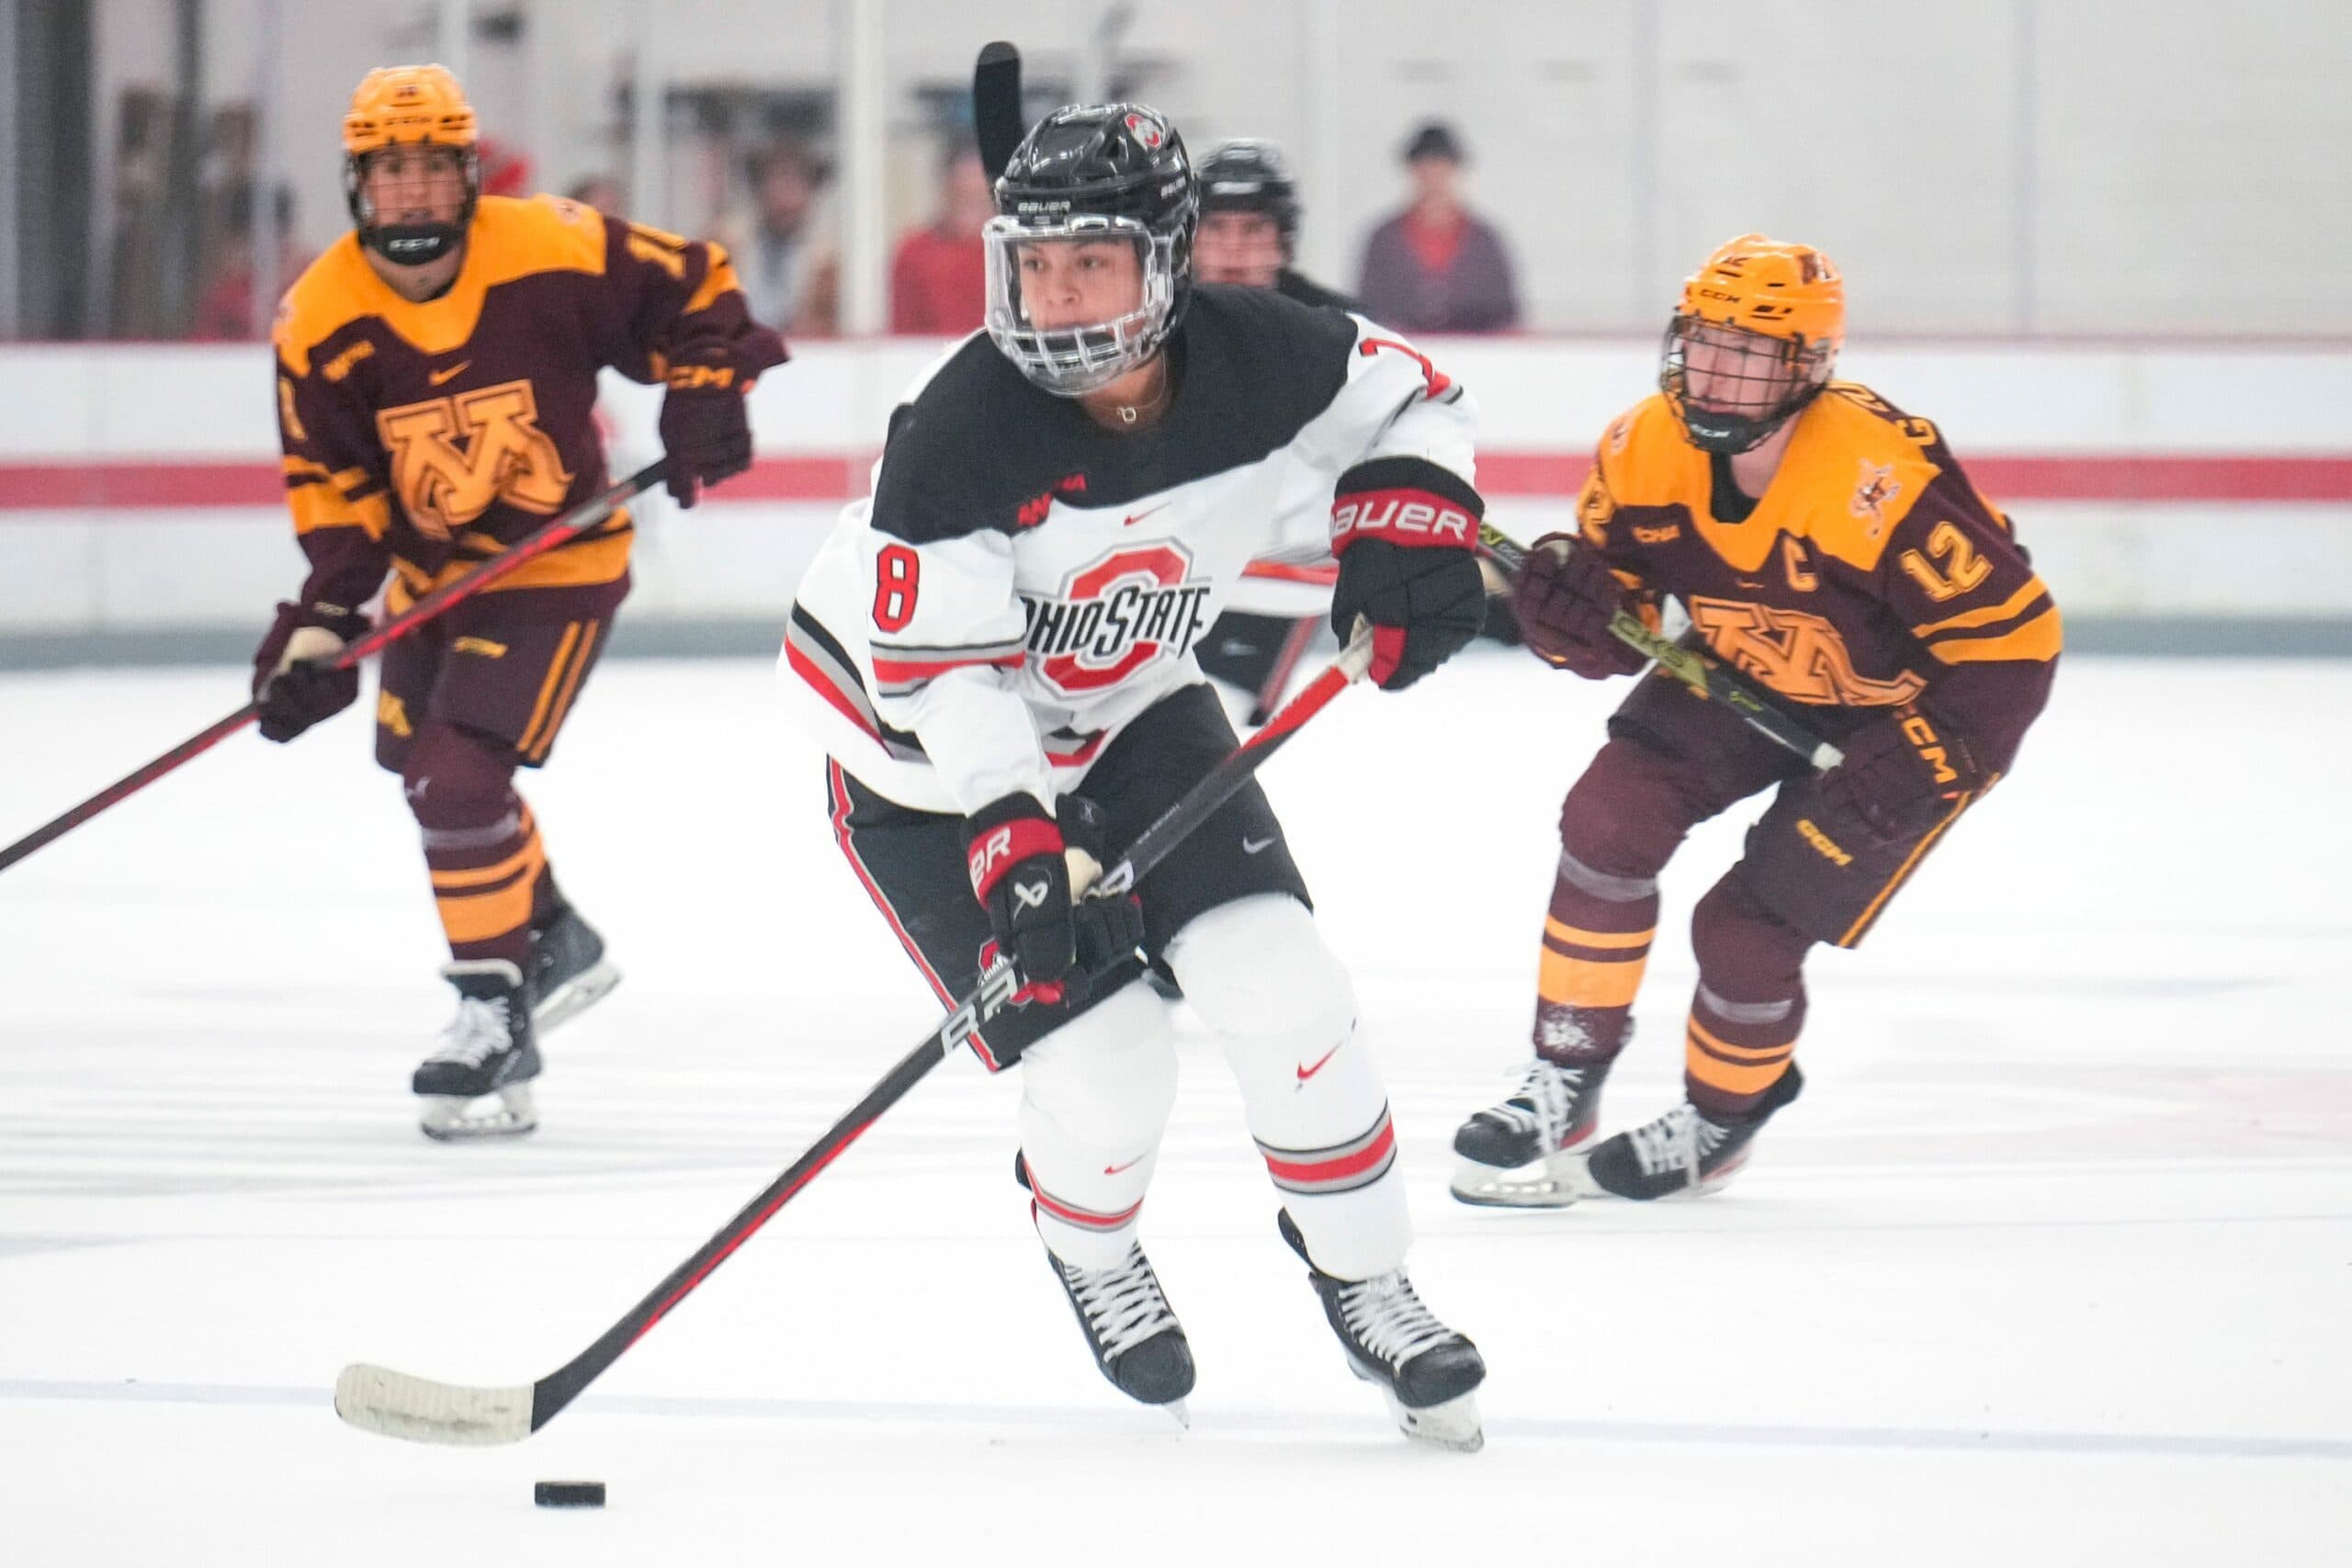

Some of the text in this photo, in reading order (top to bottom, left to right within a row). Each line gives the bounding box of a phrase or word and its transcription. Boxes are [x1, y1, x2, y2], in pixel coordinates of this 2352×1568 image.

[1329, 501, 1469, 542] AUER
[873, 542, 921, 635] 8
[1781, 535, 1818, 592] C
[1900, 521, 1994, 603] 12
[1898, 708, 1959, 784] CM
